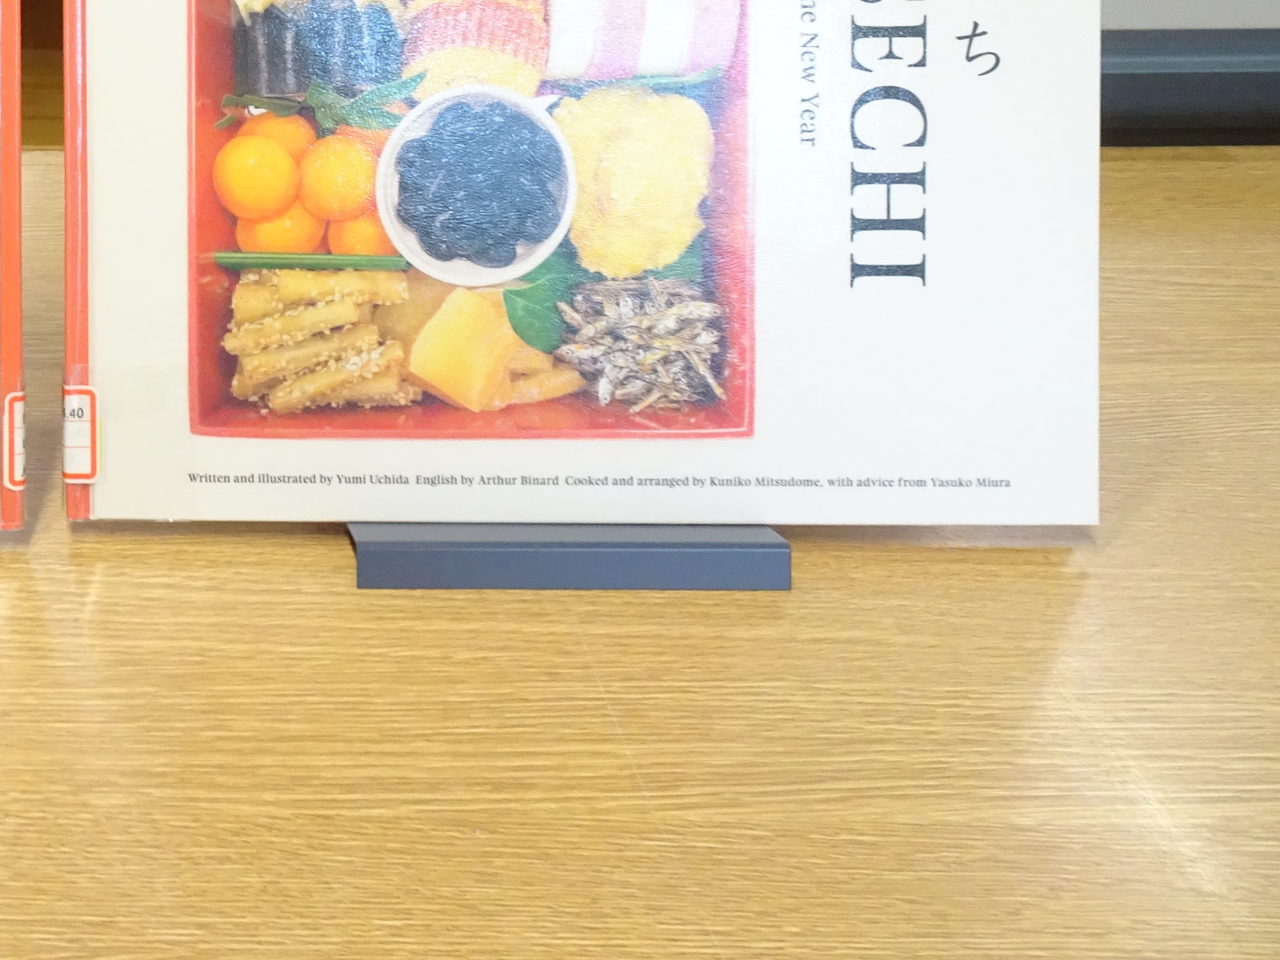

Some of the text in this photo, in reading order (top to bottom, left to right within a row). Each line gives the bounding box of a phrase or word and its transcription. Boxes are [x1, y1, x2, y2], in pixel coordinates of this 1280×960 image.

[800, 33, 820, 84] New
[800, 92, 821, 147] Year
[188, 473, 1011, 489] Written and illustrated by Yumi Uchida English by Arthur Binard Cooked and arranged by Kuniko Mitsudome, with advice from Yasuko Miura
